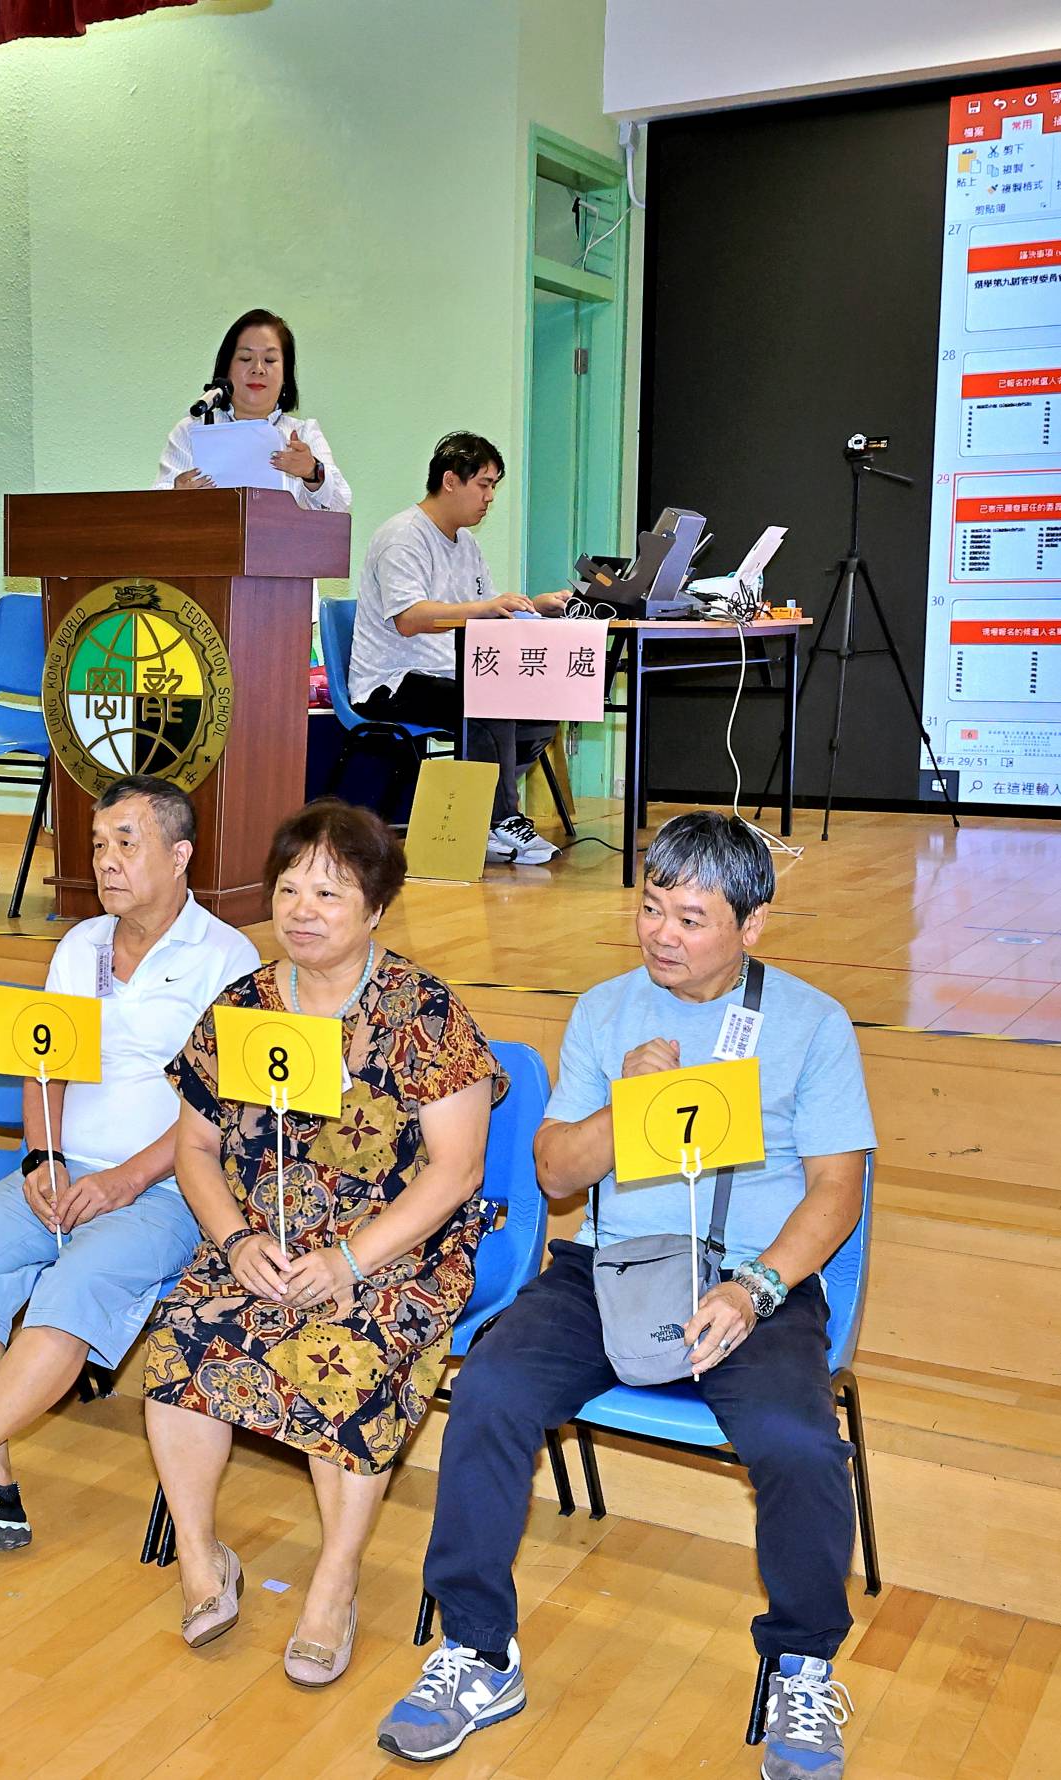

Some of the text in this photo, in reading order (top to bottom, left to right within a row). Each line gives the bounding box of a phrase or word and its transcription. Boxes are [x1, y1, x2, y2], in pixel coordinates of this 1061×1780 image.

[1011, 119, 1032, 130] 常用
[1004, 143, 1024, 155] 剪下
[1003, 163, 1023, 174] 複製
[957, 177, 977, 187] 貼上
[1002, 180, 1043, 194] 複製格式
[975, 203, 1006, 215] 剪貼簿
[948, 224, 962, 235] 27
[942, 350, 956, 360] 28
[936, 473, 950, 485] 29
[931, 595, 945, 606] 30
[471, 646, 597, 678] 核票處
[46, 601, 230, 737] LUNG KONG WORLD FEDERATION SCHOOL
[926, 716, 938, 726] 31
[268, 1046, 289, 1082] 8
[677, 1105, 699, 1144] 7
[651, 1330, 673, 1339] NORTH
[658, 1335, 675, 1343] FACE
